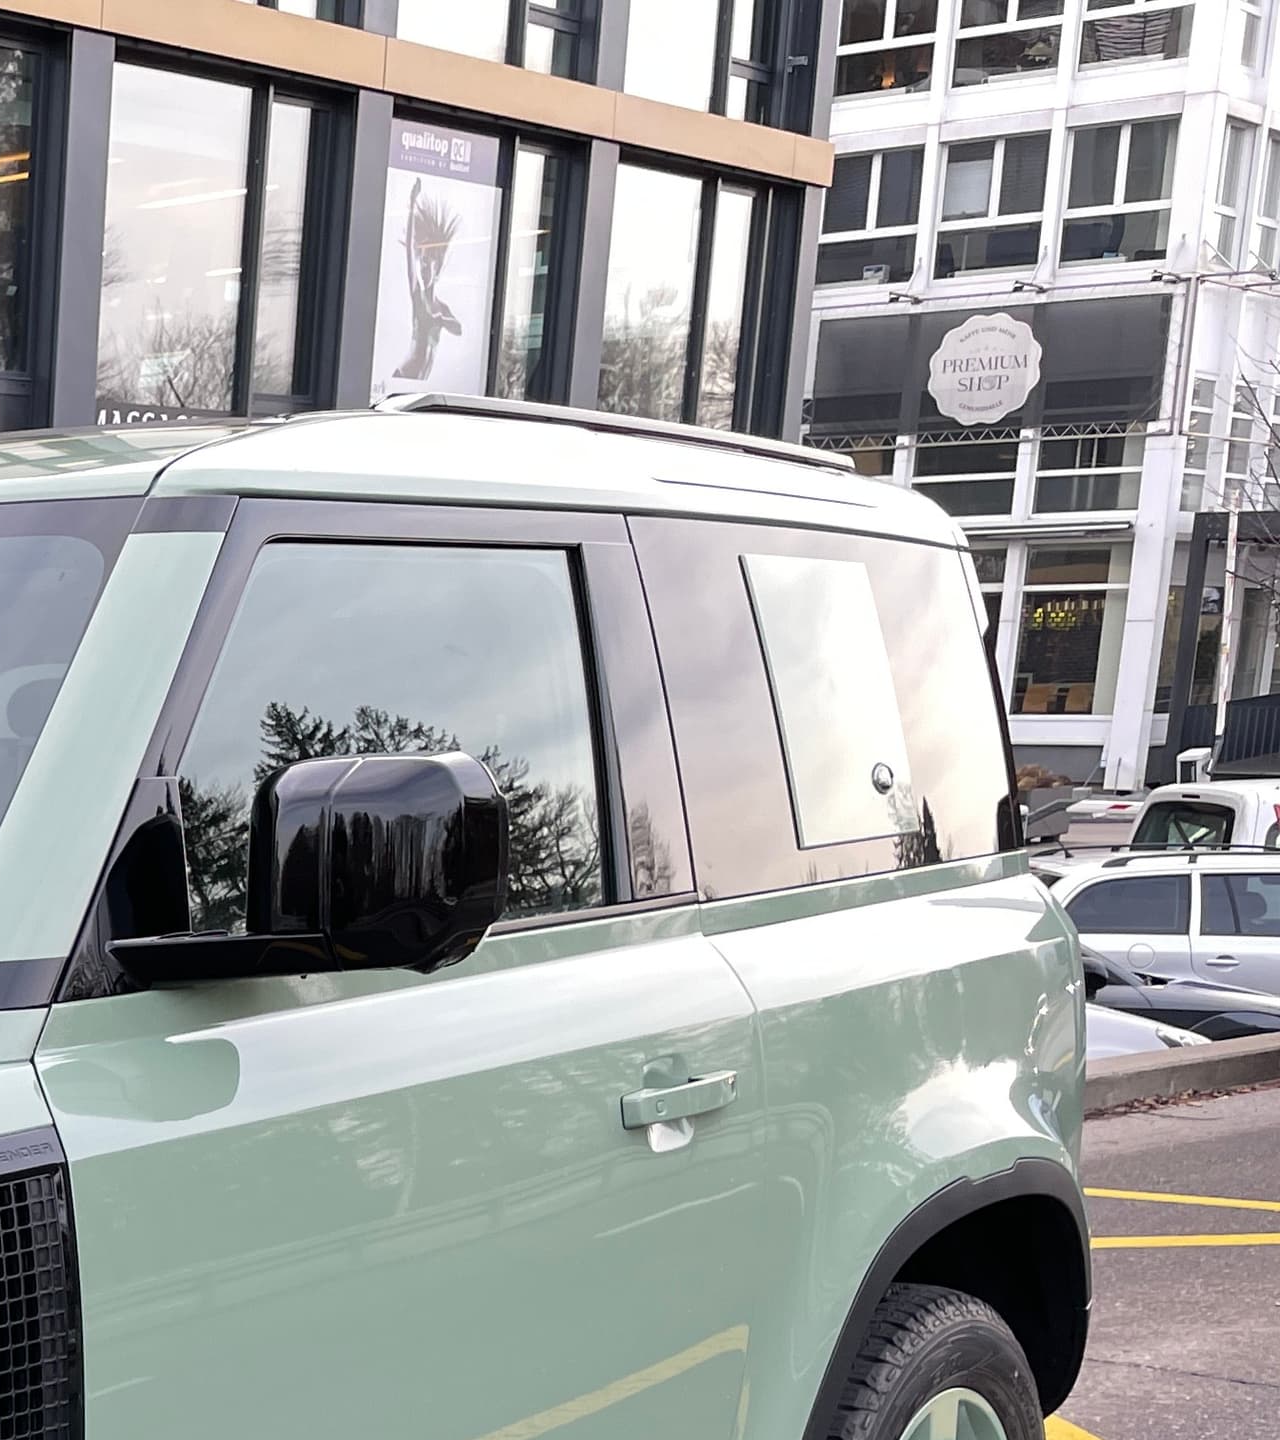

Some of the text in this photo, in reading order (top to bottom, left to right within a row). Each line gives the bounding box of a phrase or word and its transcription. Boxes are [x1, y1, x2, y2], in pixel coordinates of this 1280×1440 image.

[401, 131, 449, 157] qualitop
[942, 354, 1028, 374] PREMIUM
[956, 375, 1009, 392] SHOP
